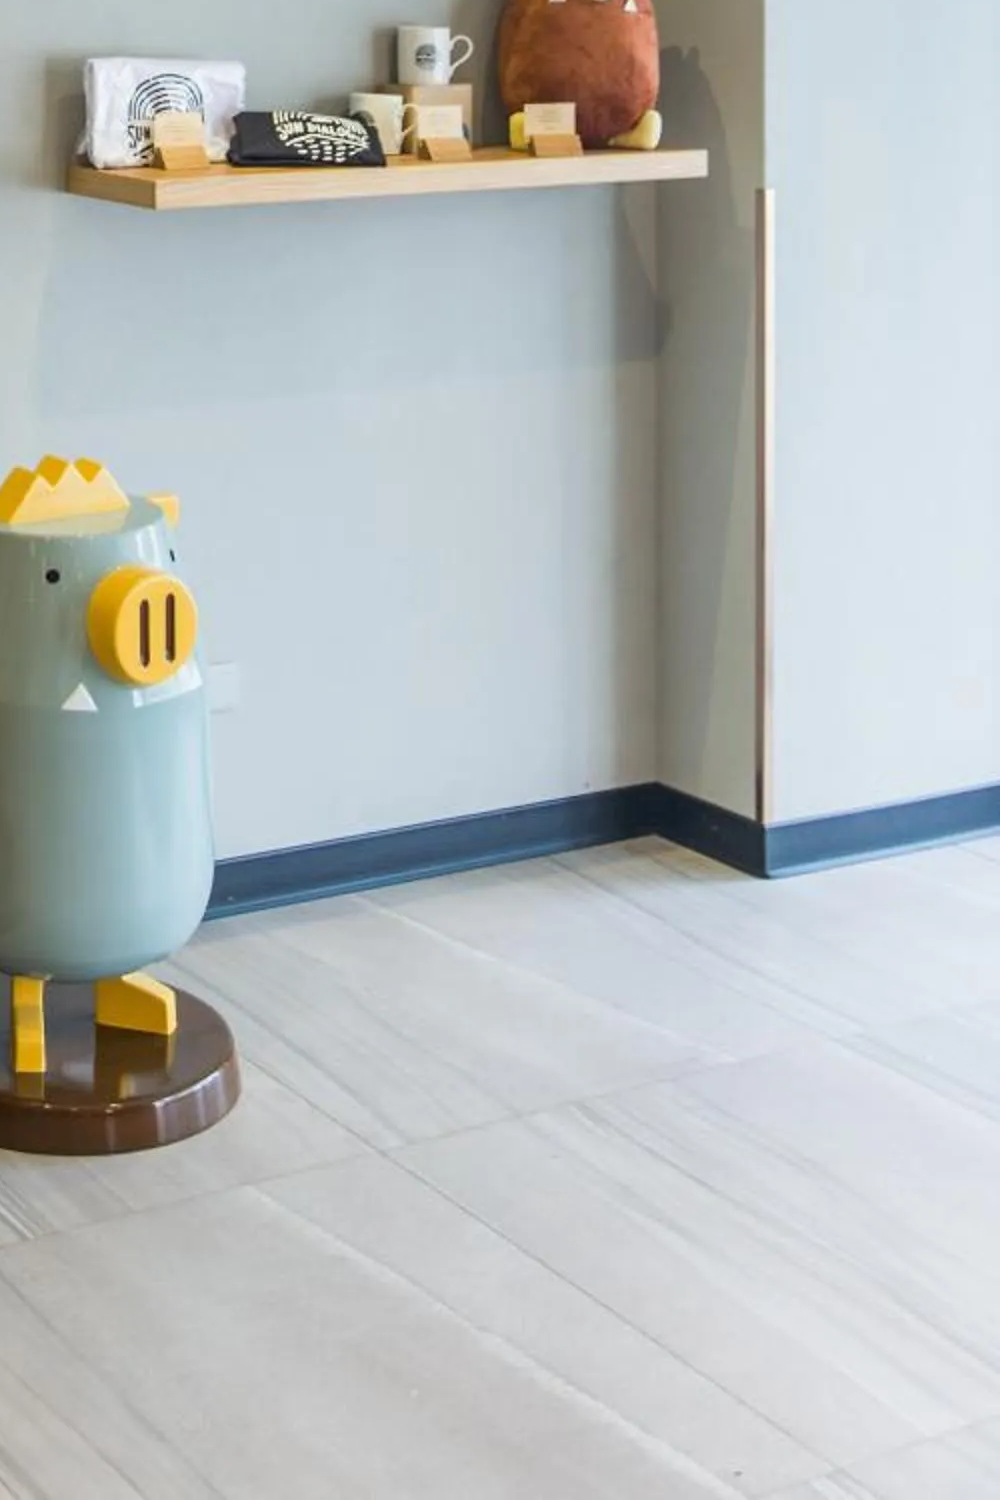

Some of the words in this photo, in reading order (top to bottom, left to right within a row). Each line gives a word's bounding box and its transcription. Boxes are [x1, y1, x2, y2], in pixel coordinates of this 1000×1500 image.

[127, 124, 151, 149] SUN
[276, 121, 304, 141] SUN
[306, 122, 370, 147] DIALO
